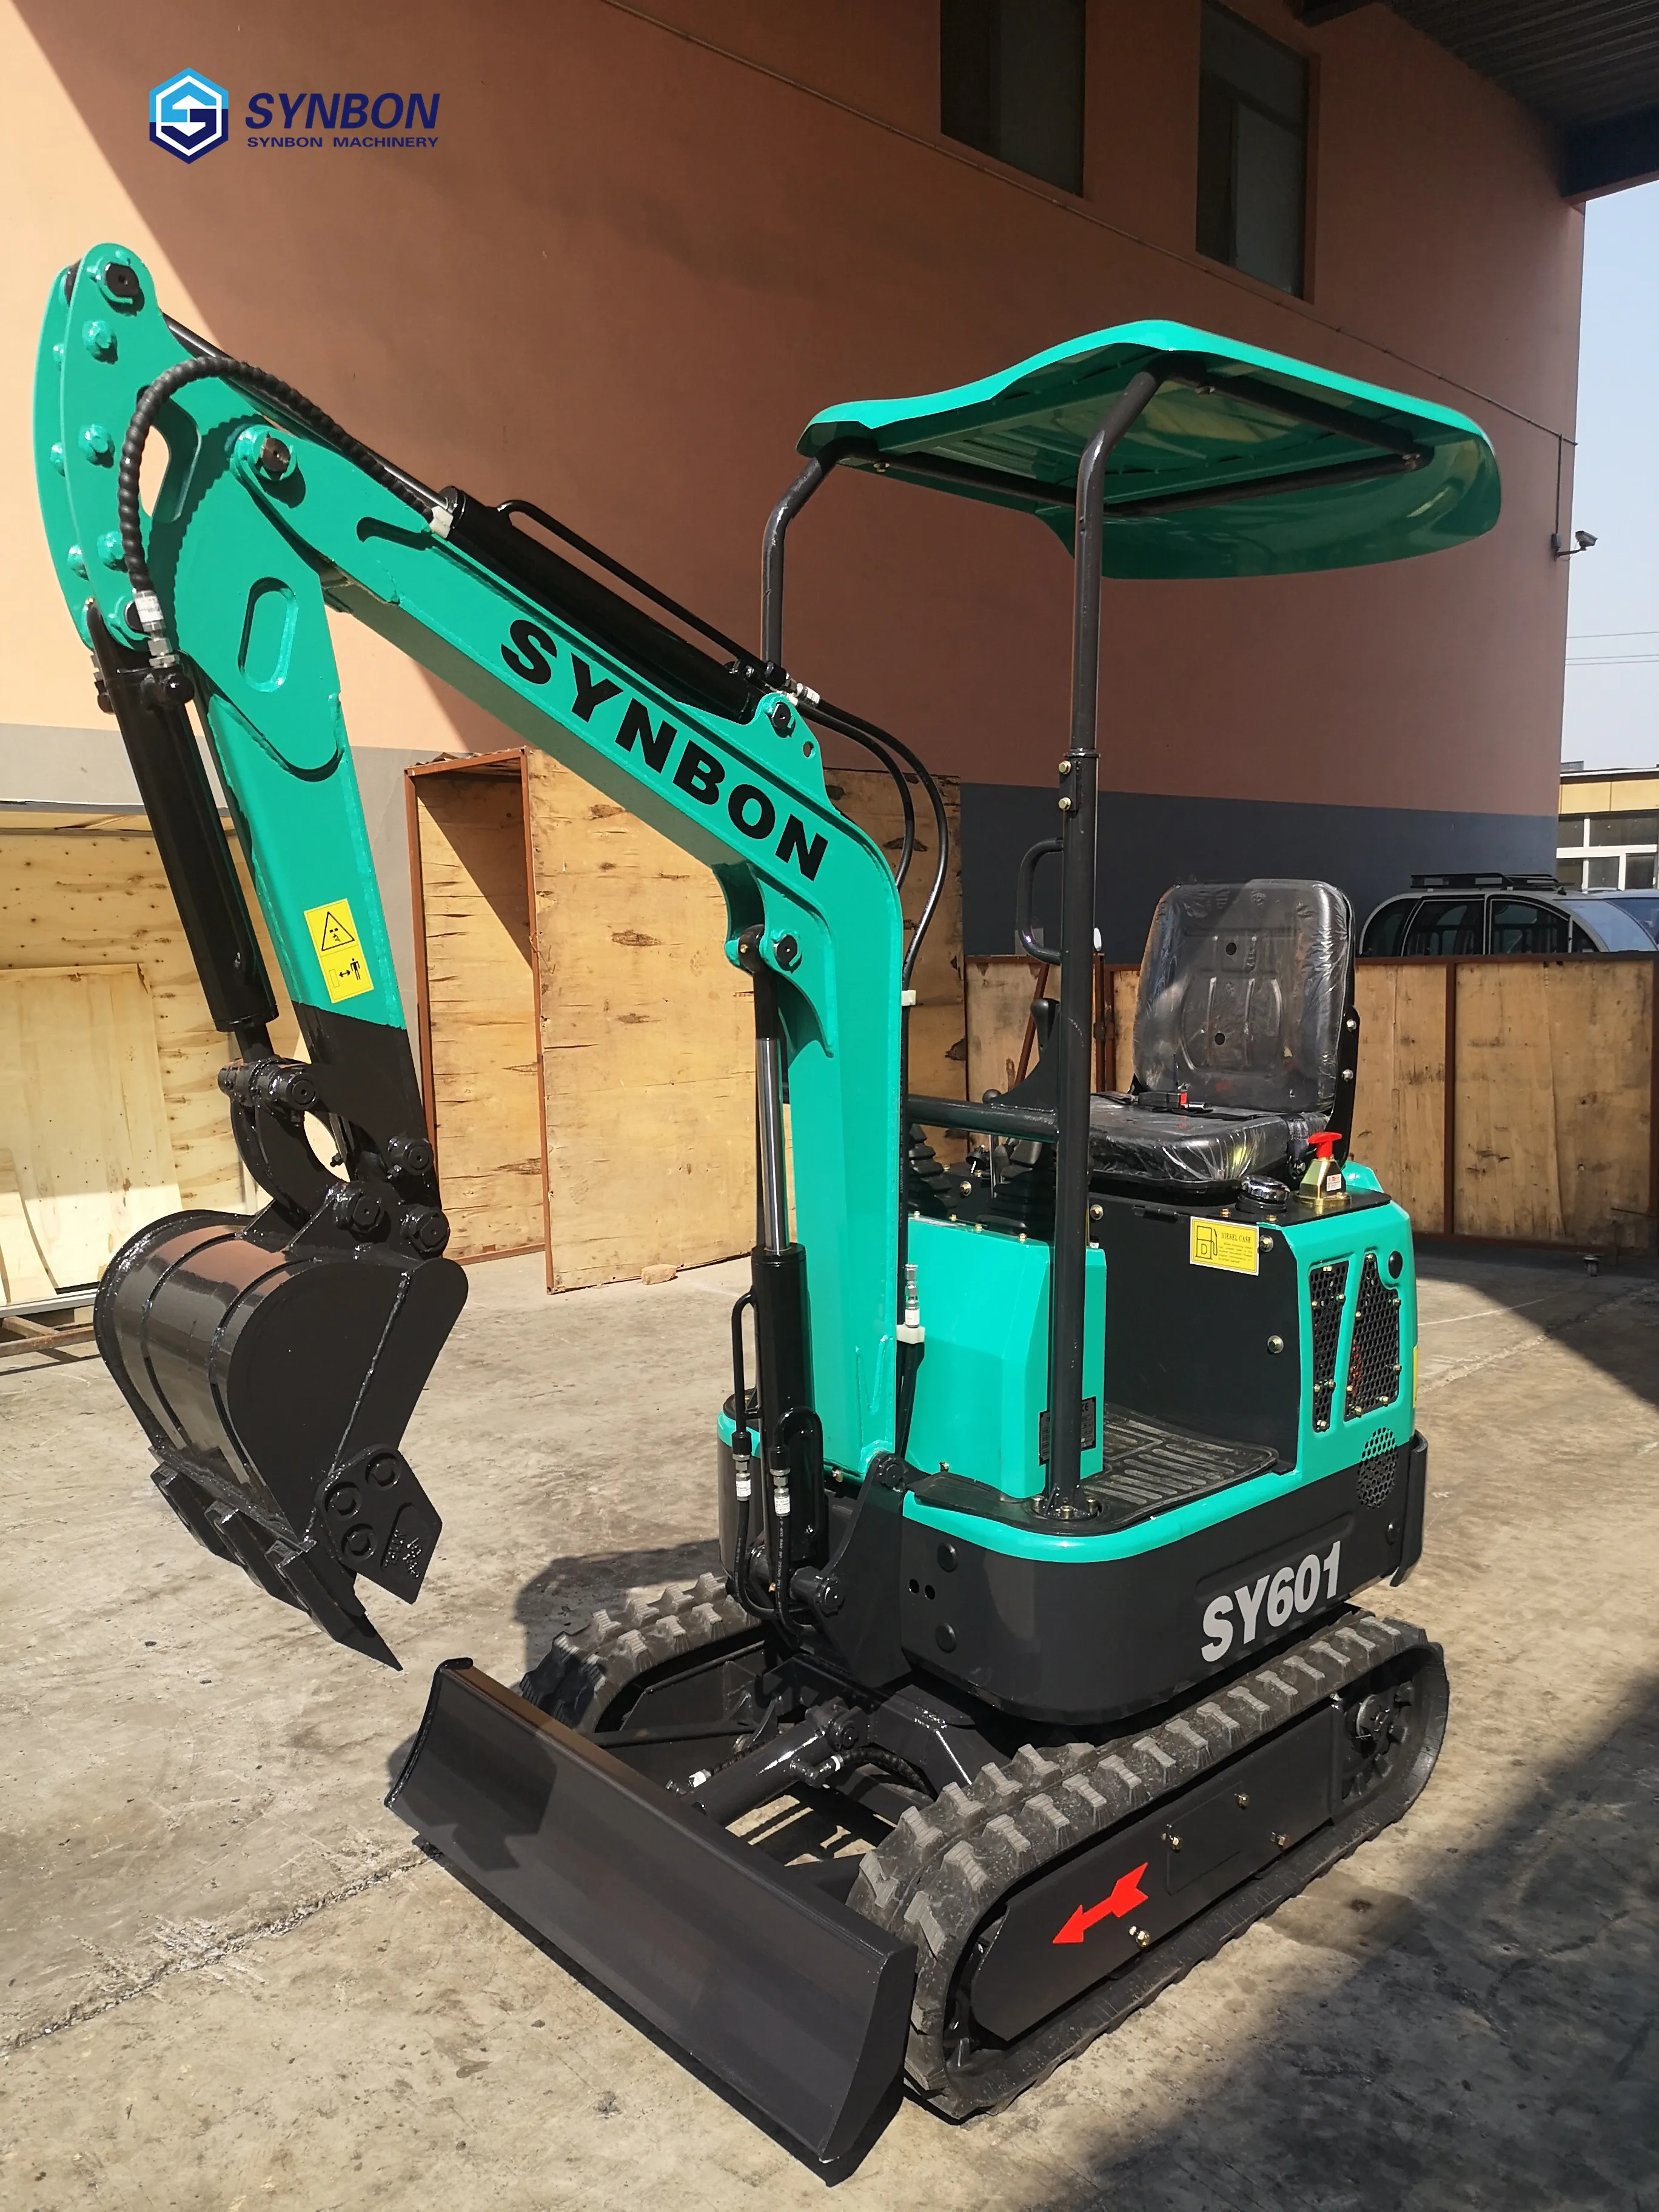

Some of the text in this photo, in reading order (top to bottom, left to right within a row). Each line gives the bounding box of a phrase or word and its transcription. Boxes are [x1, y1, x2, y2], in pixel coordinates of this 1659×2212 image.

[501, 619, 828, 882] SYNBON
[1201, 1244, 1208, 1255] D
[1221, 1232, 1251, 1244] DIESEL CASE
[1201, 1540, 1341, 1662] SY601
